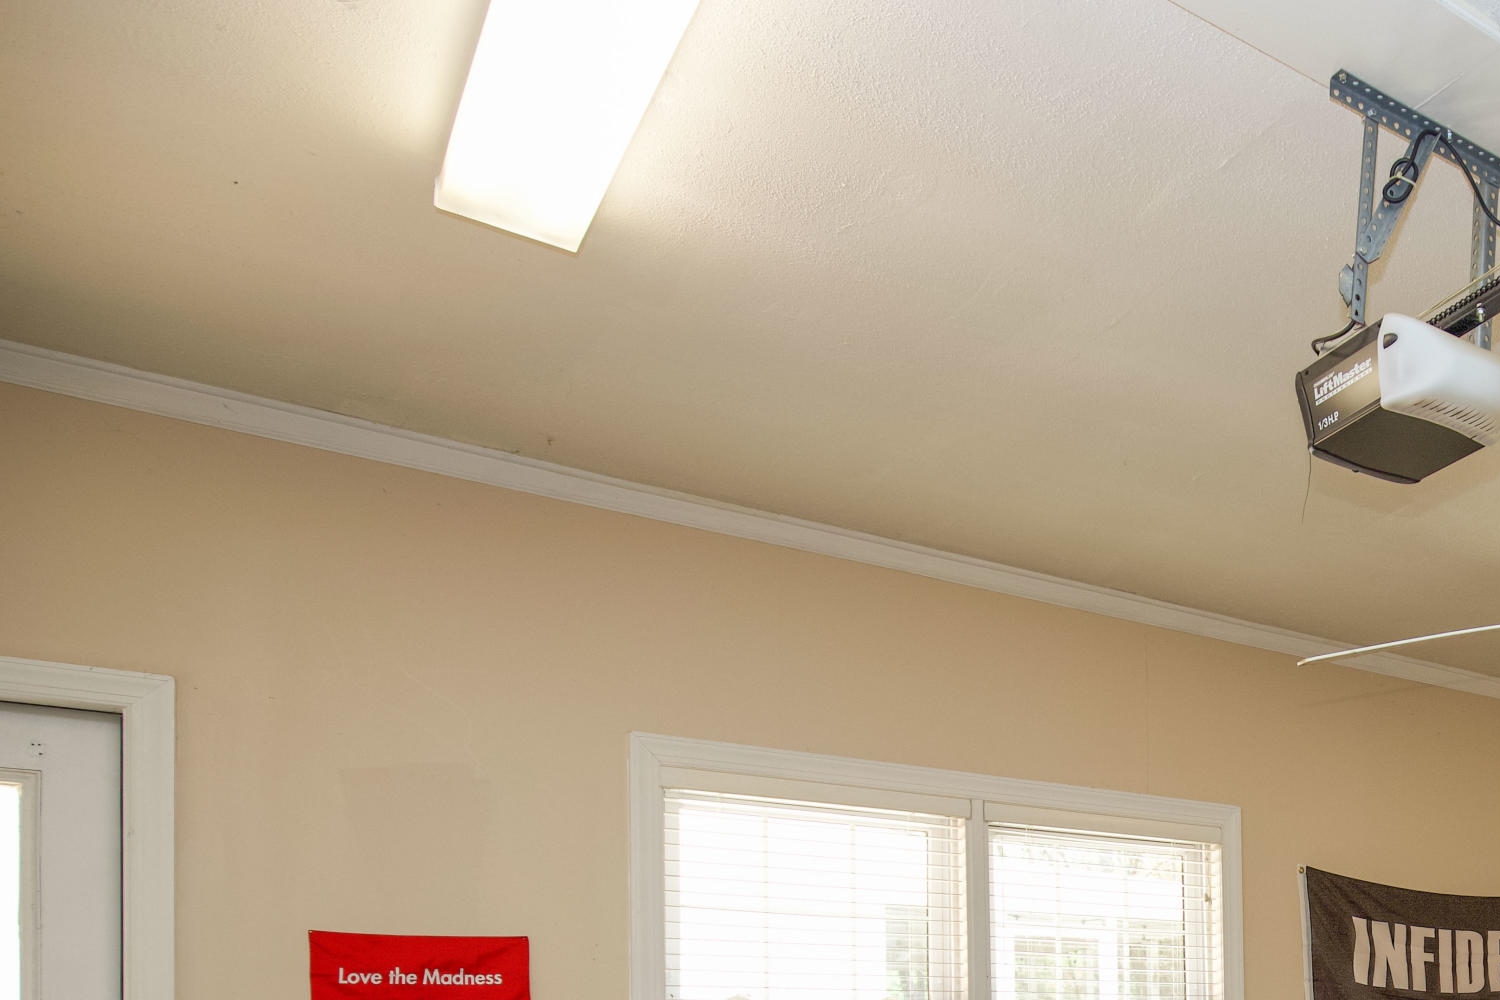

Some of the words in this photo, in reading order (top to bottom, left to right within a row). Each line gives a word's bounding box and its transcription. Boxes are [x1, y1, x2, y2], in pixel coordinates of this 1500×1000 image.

[1313, 357, 1372, 400] LiftMaster
[338, 967, 383, 985] Love
[388, 967, 417, 985] the
[422, 968, 503, 986] Madness
